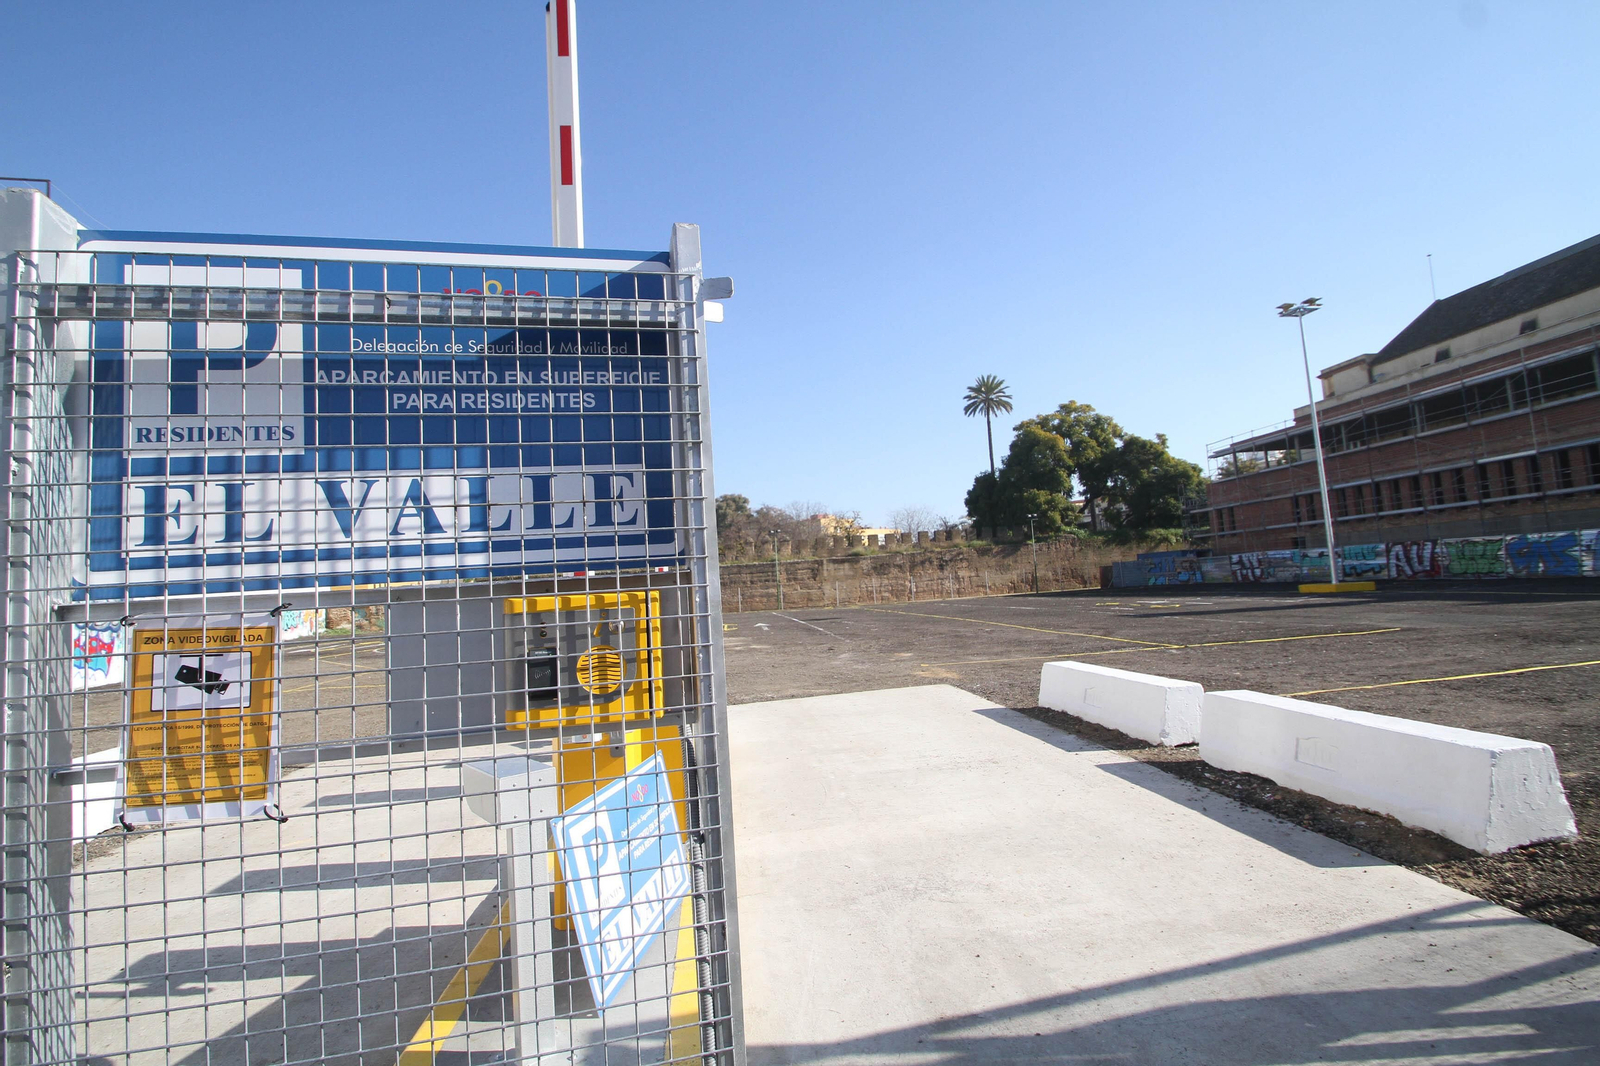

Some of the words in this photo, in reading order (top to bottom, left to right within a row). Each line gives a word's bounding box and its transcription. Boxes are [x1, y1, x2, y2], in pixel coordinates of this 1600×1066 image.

[169, 288, 279, 415] P
[350, 337, 439, 354] Delegación
[468, 339, 542, 355] Seguridad
[317, 369, 498, 386] APARCAMIENTO
[504, 370, 533, 386] EN
[540, 371, 661, 386] SUPERFICIE
[392, 393, 454, 410] PARA
[461, 392, 596, 410] RESIDENTES
[135, 425, 295, 444] RESIDENTES
[134, 482, 277, 548] EL
[315, 471, 640, 540] VALLE
[143, 636, 176, 645] ZONA
[178, 634, 264, 645] VIDEOVIGILADA
[582, 825, 609, 898] P
